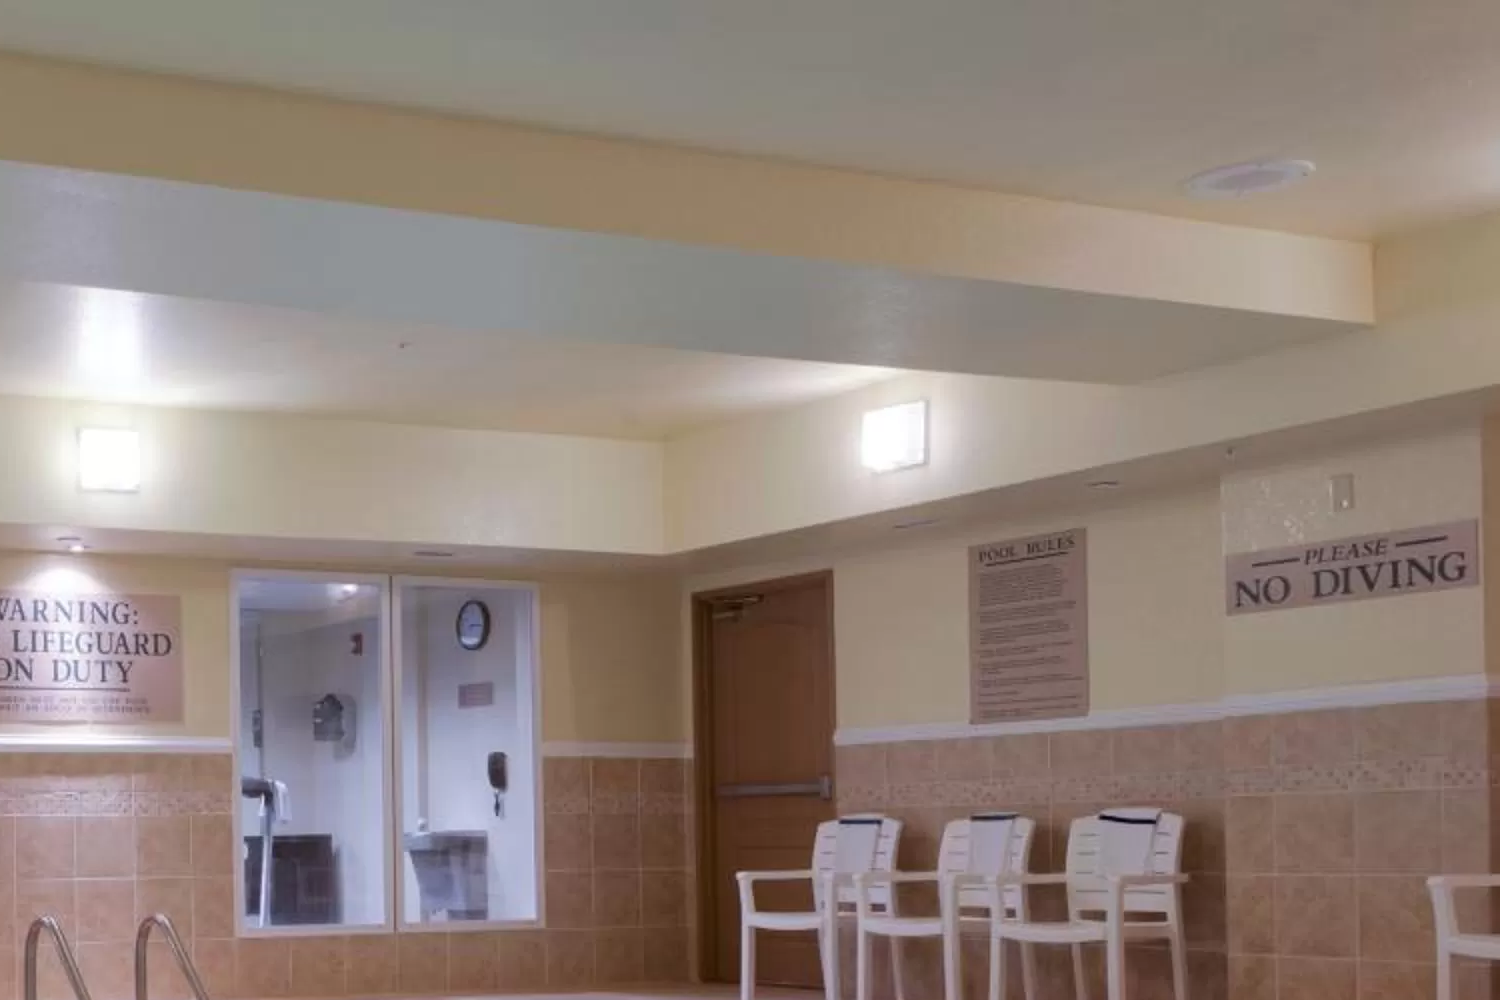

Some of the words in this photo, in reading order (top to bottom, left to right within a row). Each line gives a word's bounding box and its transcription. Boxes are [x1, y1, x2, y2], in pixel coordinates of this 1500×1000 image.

[1303, 538, 1389, 565] PLEASE
[1234, 575, 1291, 608] NO
[1312, 551, 1467, 599] DIVING
[12, 629, 172, 656] LIFEGUARD
[52, 660, 134, 683] DUTY
